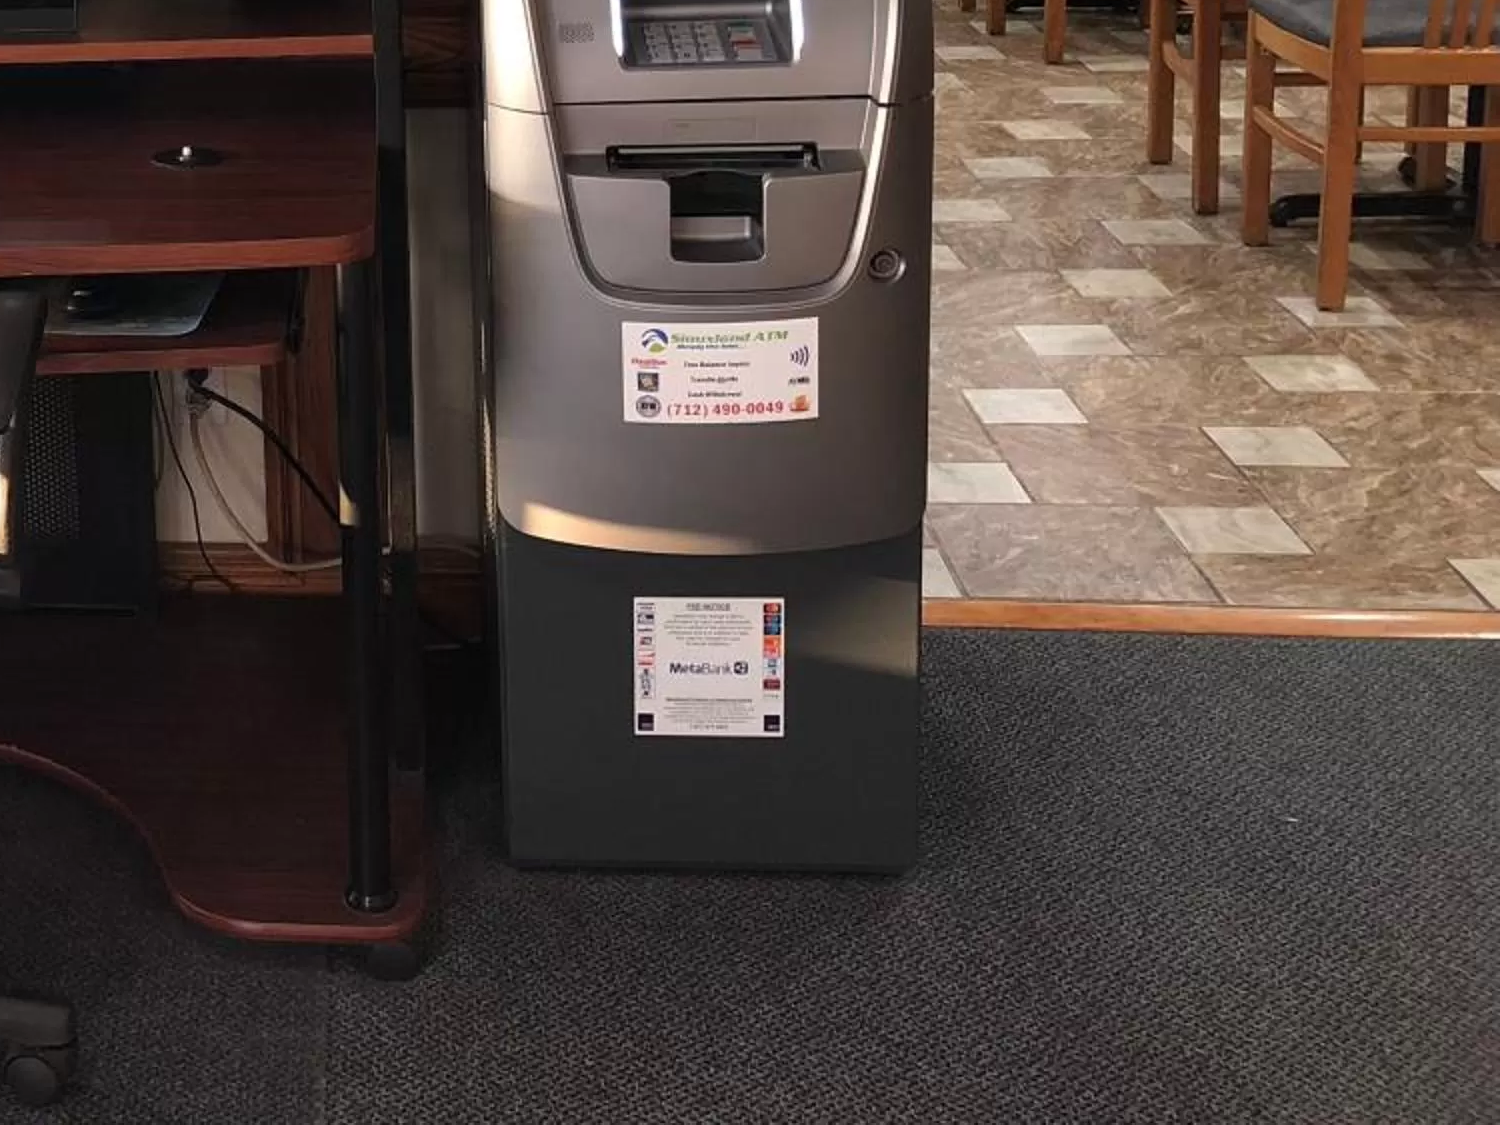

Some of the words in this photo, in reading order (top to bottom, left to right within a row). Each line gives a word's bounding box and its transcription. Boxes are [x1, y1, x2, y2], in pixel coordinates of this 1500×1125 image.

[753, 330, 789, 342] ATM
[667, 403, 709, 418] (712)
[713, 401, 784, 416] 490-0049
[669, 662, 731, 675] MetaBank
